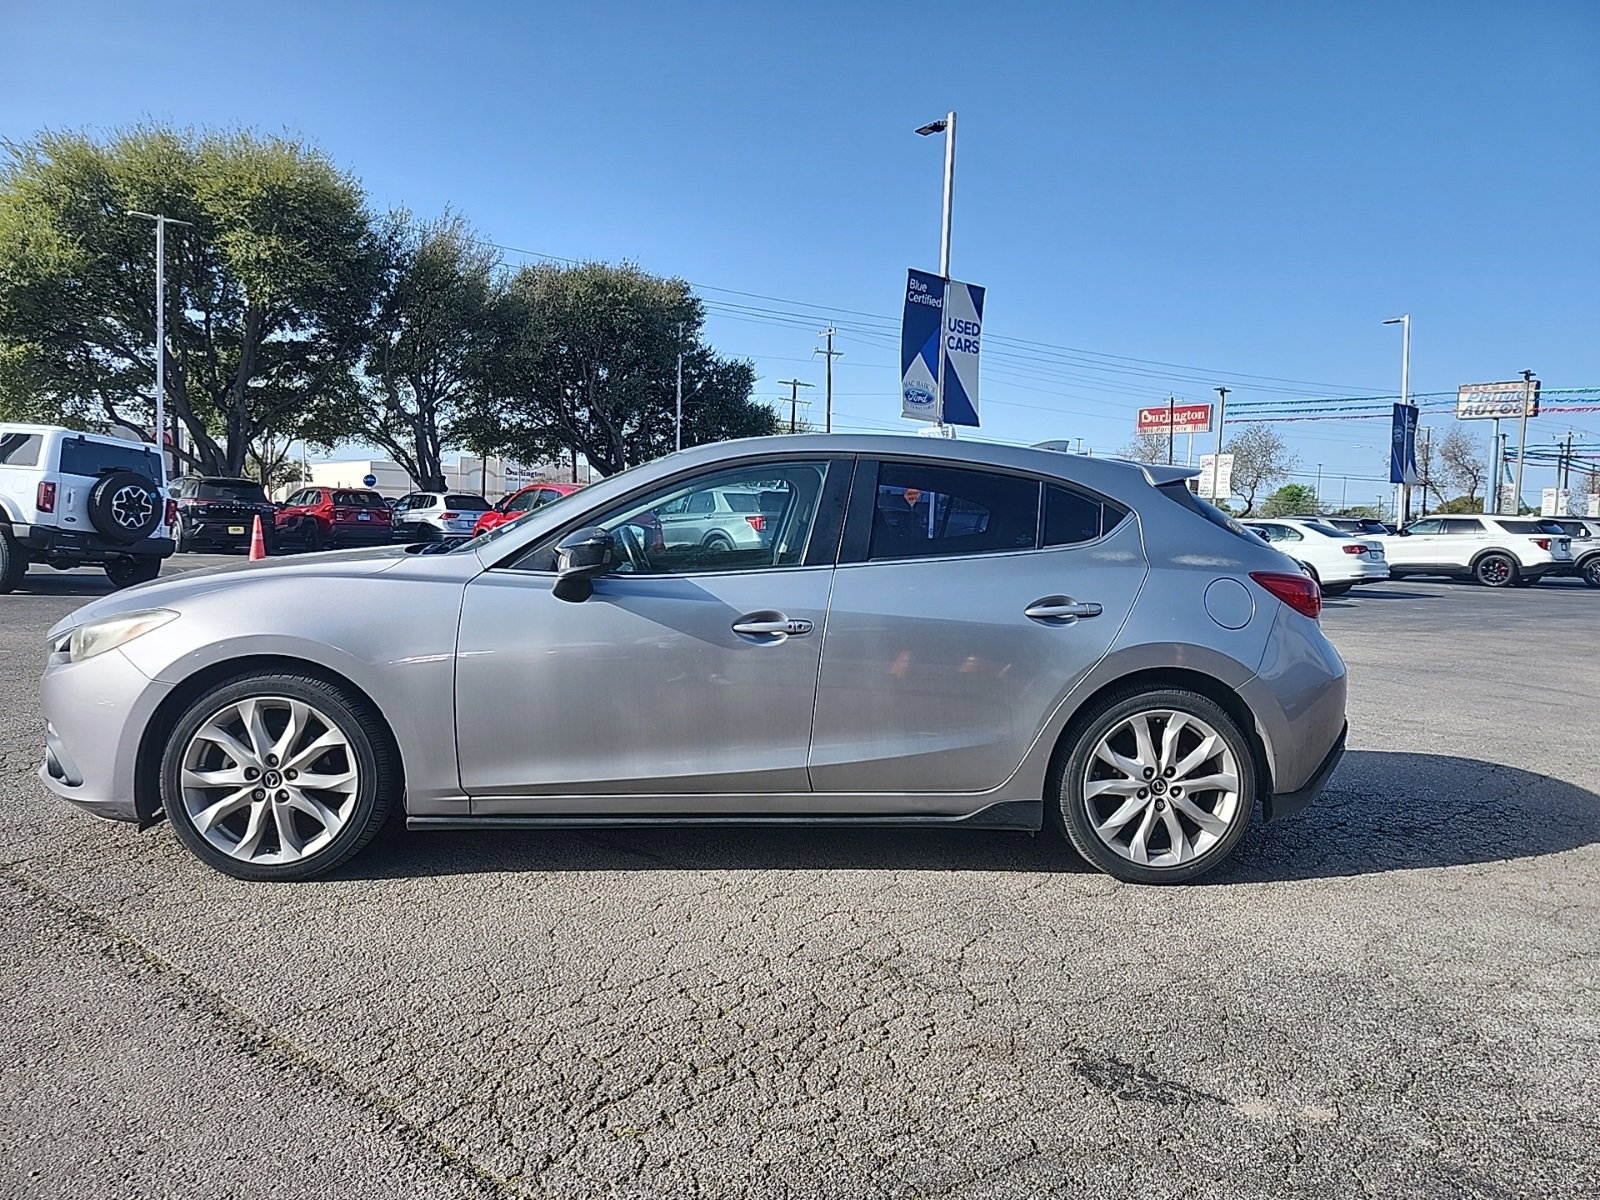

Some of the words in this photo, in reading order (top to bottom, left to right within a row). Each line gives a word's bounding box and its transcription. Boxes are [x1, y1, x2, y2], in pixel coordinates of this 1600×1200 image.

[909, 278, 928, 293] Blue
[907, 291, 942, 308] Certified
[948, 317, 981, 337] USED
[947, 336, 980, 354] CARS
[907, 389, 928, 403] Ford
[1141, 409, 1206, 424] Burlington
